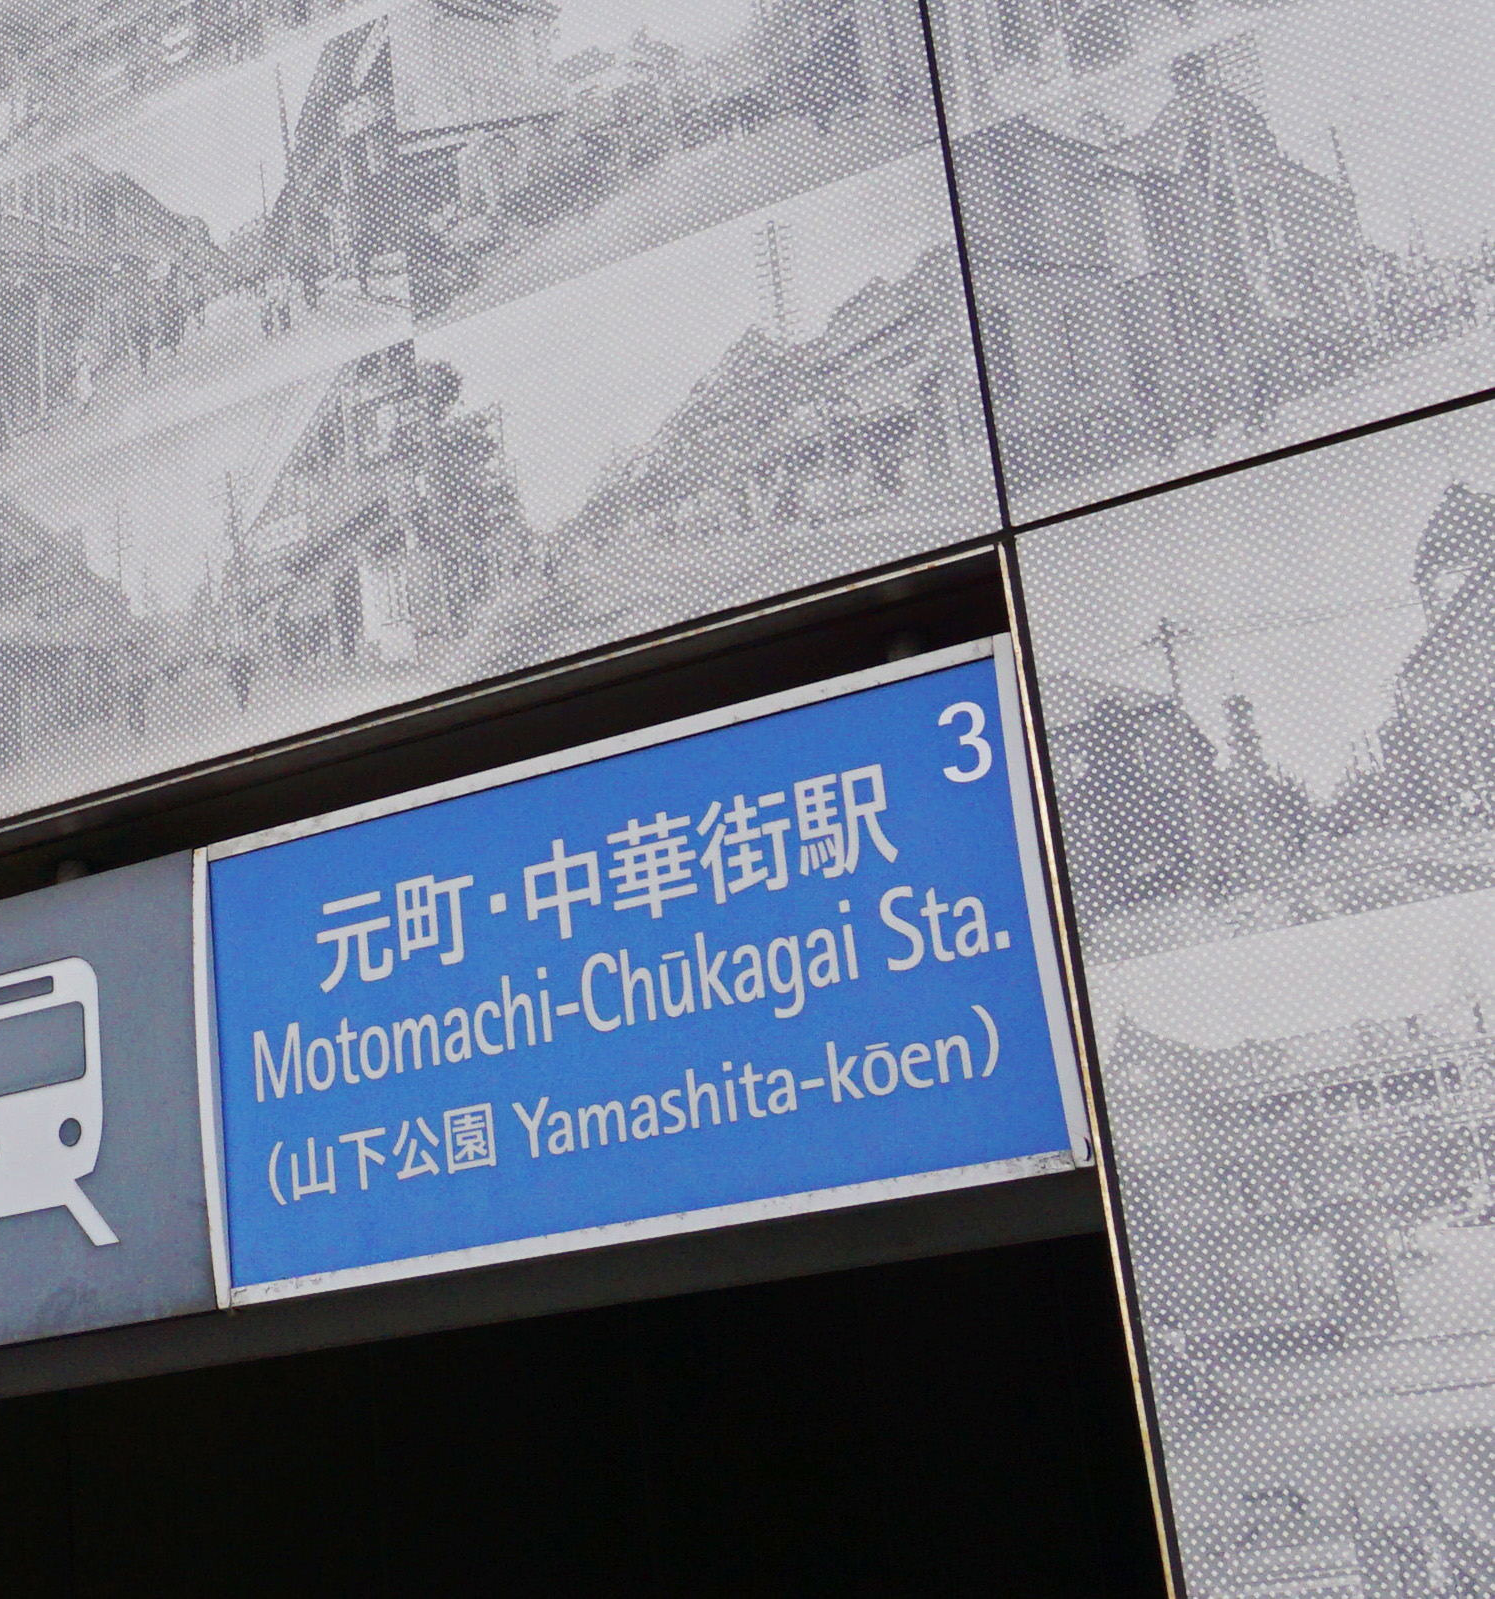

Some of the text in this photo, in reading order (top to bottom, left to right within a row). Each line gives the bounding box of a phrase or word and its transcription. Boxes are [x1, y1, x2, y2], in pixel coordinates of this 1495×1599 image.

[937, 701, 993, 783] 3
[316, 763, 899, 993] 元町・中華街駅
[253, 885, 1011, 1103] Motomachi-Chūkagai Sta.
[268, 1004, 1000, 1206] (山下公園 Yamashita-kōen)
